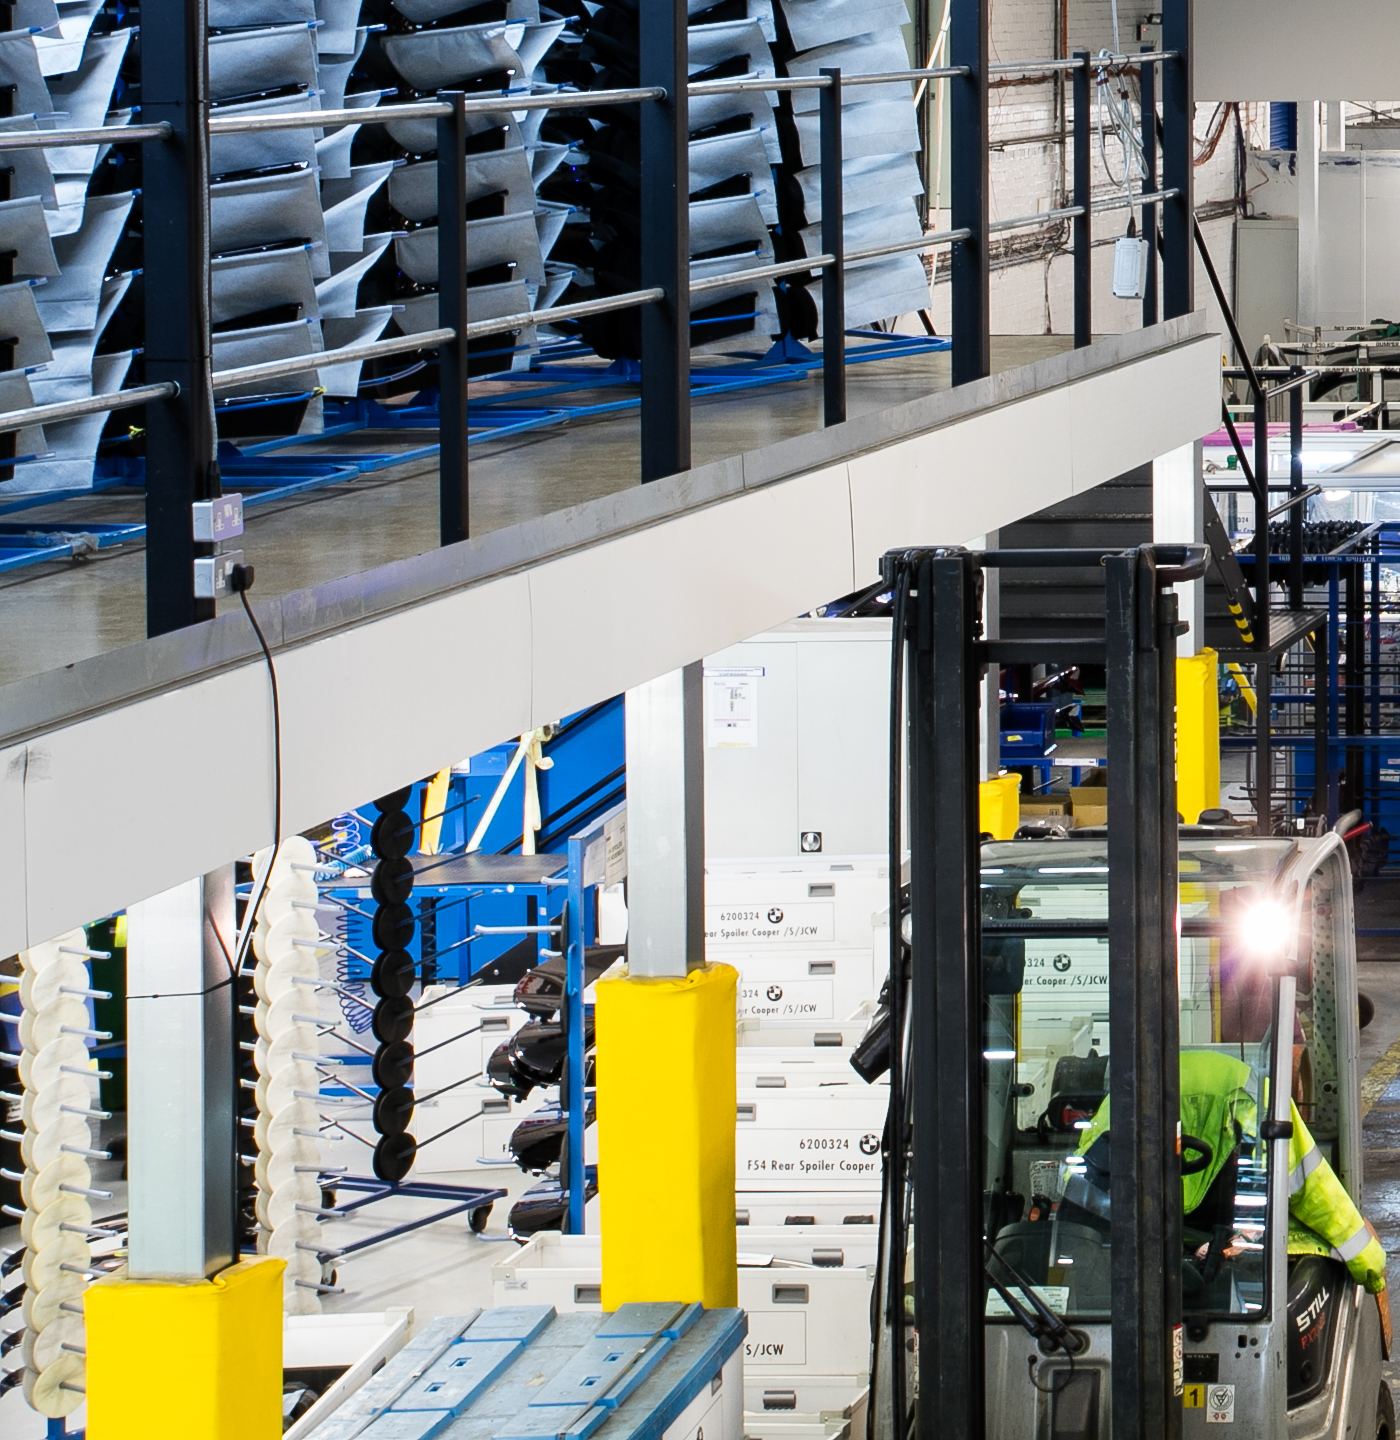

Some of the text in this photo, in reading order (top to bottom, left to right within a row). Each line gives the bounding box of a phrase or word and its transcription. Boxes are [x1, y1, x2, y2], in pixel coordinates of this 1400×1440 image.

[720, 912, 760, 921] 6200324
[704, 926, 818, 939] ear Spoiler Cooper /S/JCW
[1036, 975, 1067, 987] Cooper
[1070, 975, 1108, 987] /S/JCW
[751, 1005, 779, 1016] Cooper
[783, 1004, 817, 1015] /S/JCW
[799, 1138, 849, 1150] 6200324
[747, 1159, 875, 1174] F54 Rear Spoiler Cooper
[1295, 1286, 1330, 1332] STILL
[745, 1343, 784, 1358] S/JCW
[1189, 1387, 1198, 1407] 1
